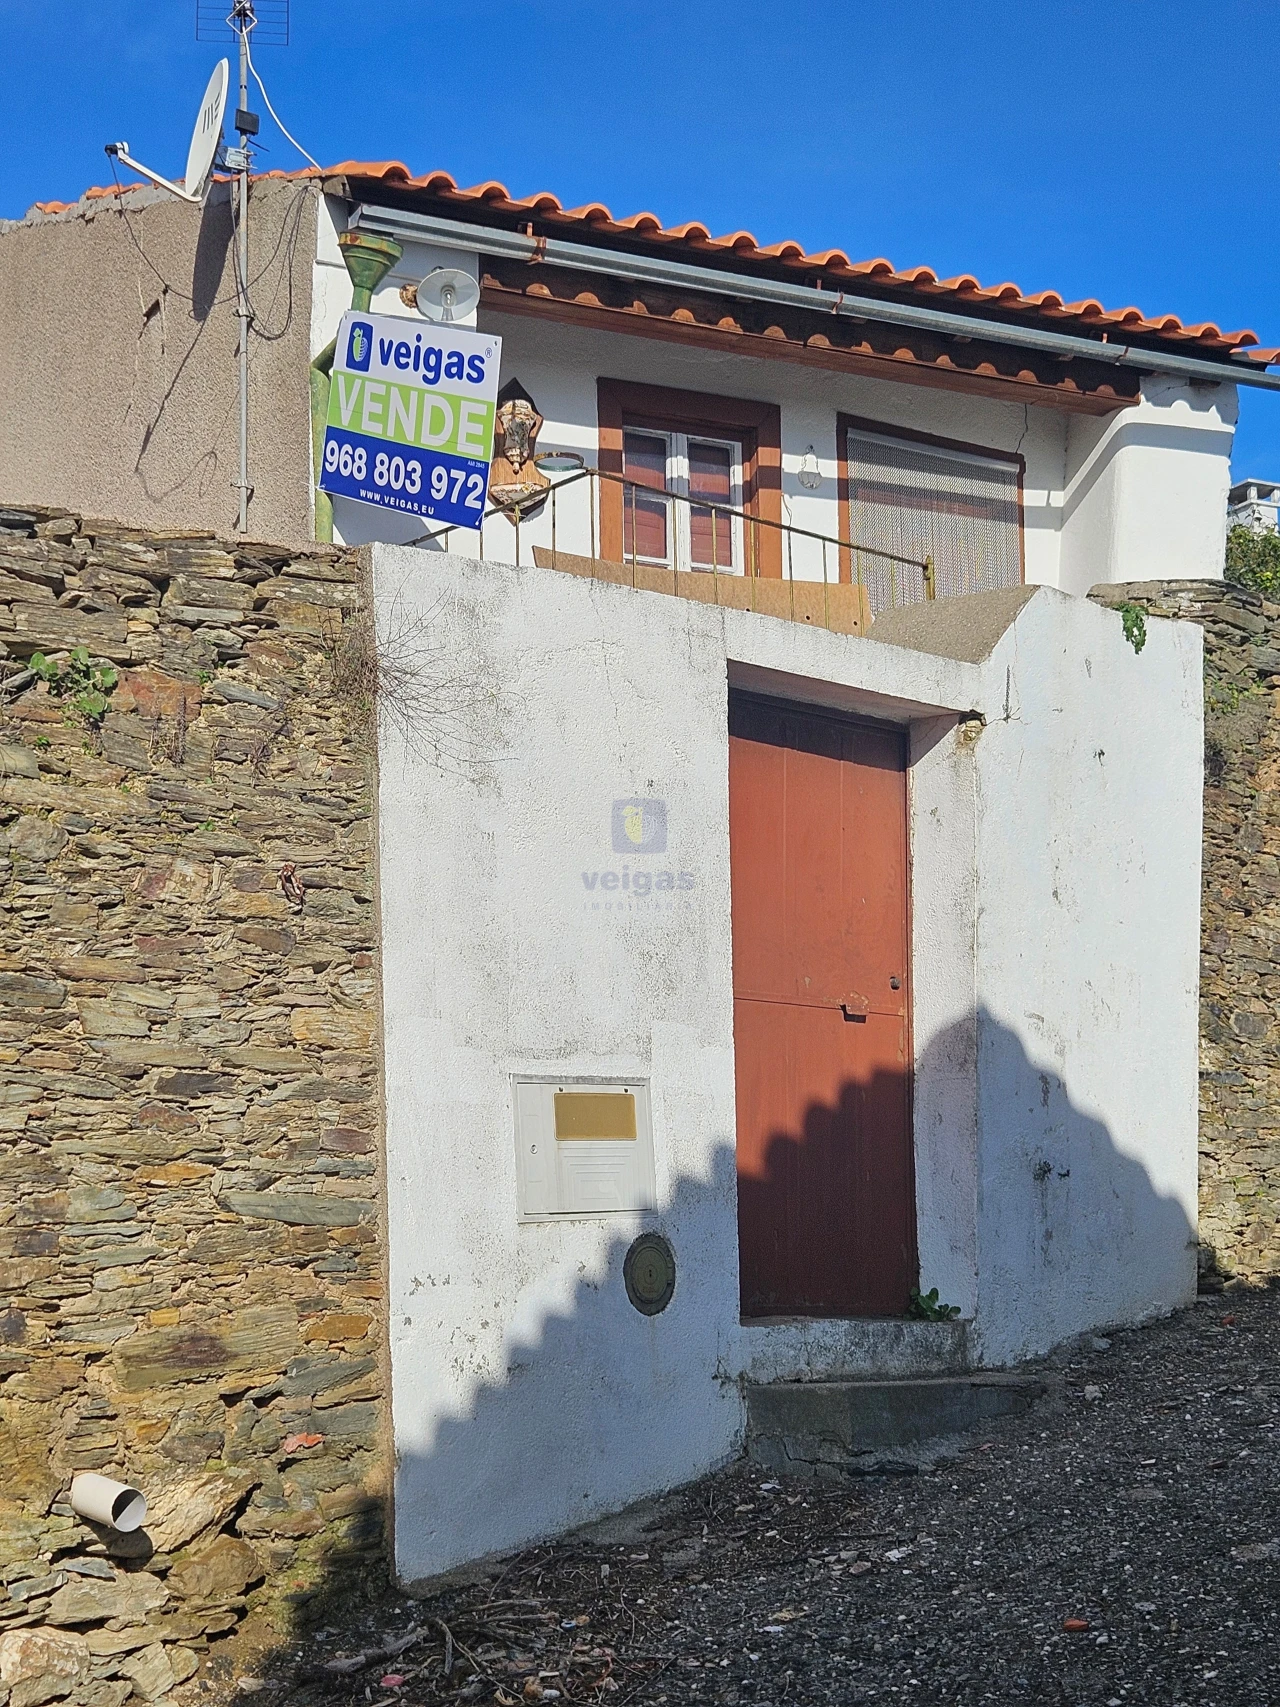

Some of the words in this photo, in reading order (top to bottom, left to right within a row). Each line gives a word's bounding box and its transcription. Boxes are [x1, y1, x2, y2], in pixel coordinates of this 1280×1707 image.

[337, 375, 488, 456] VENDE
[324, 439, 367, 481] 968
[373, 452, 422, 494] 803
[430, 465, 484, 509] 972
[359, 488, 435, 515] WWW.VEIGAS.EU
